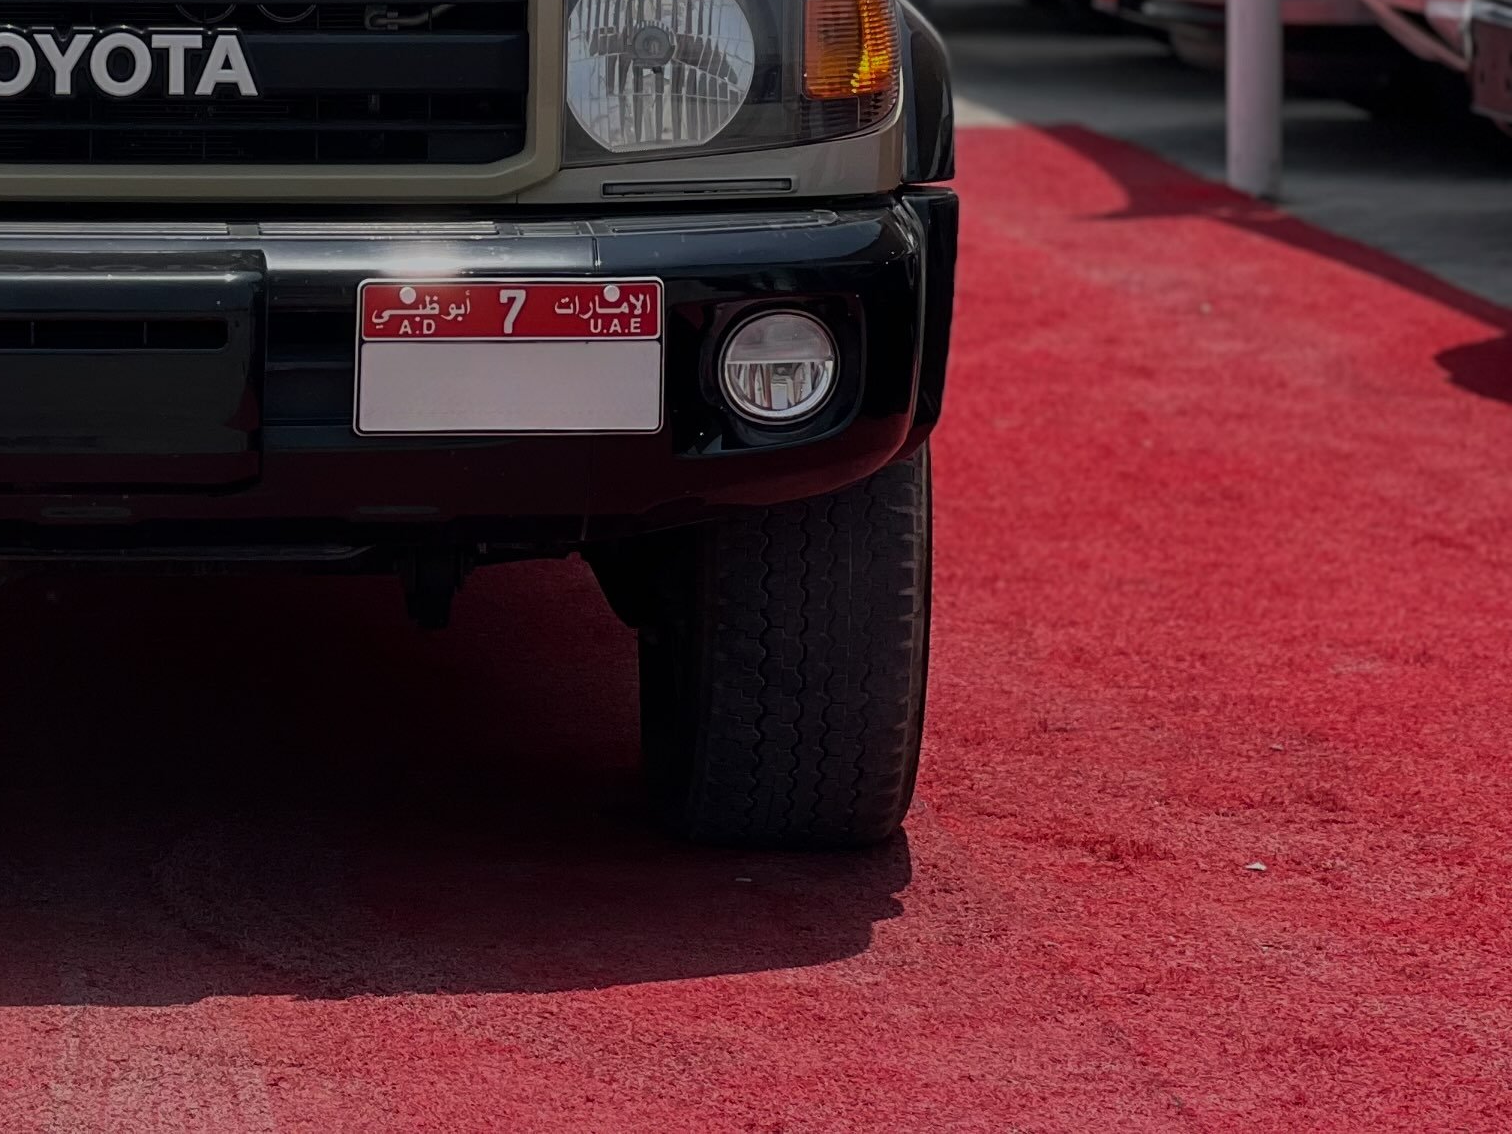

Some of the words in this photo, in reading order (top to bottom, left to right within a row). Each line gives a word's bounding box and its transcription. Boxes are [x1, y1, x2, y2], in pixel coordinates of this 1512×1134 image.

[499, 289, 527, 334] 7
[399, 319, 436, 335] A.D
[590, 318, 641, 333] U.A.E
